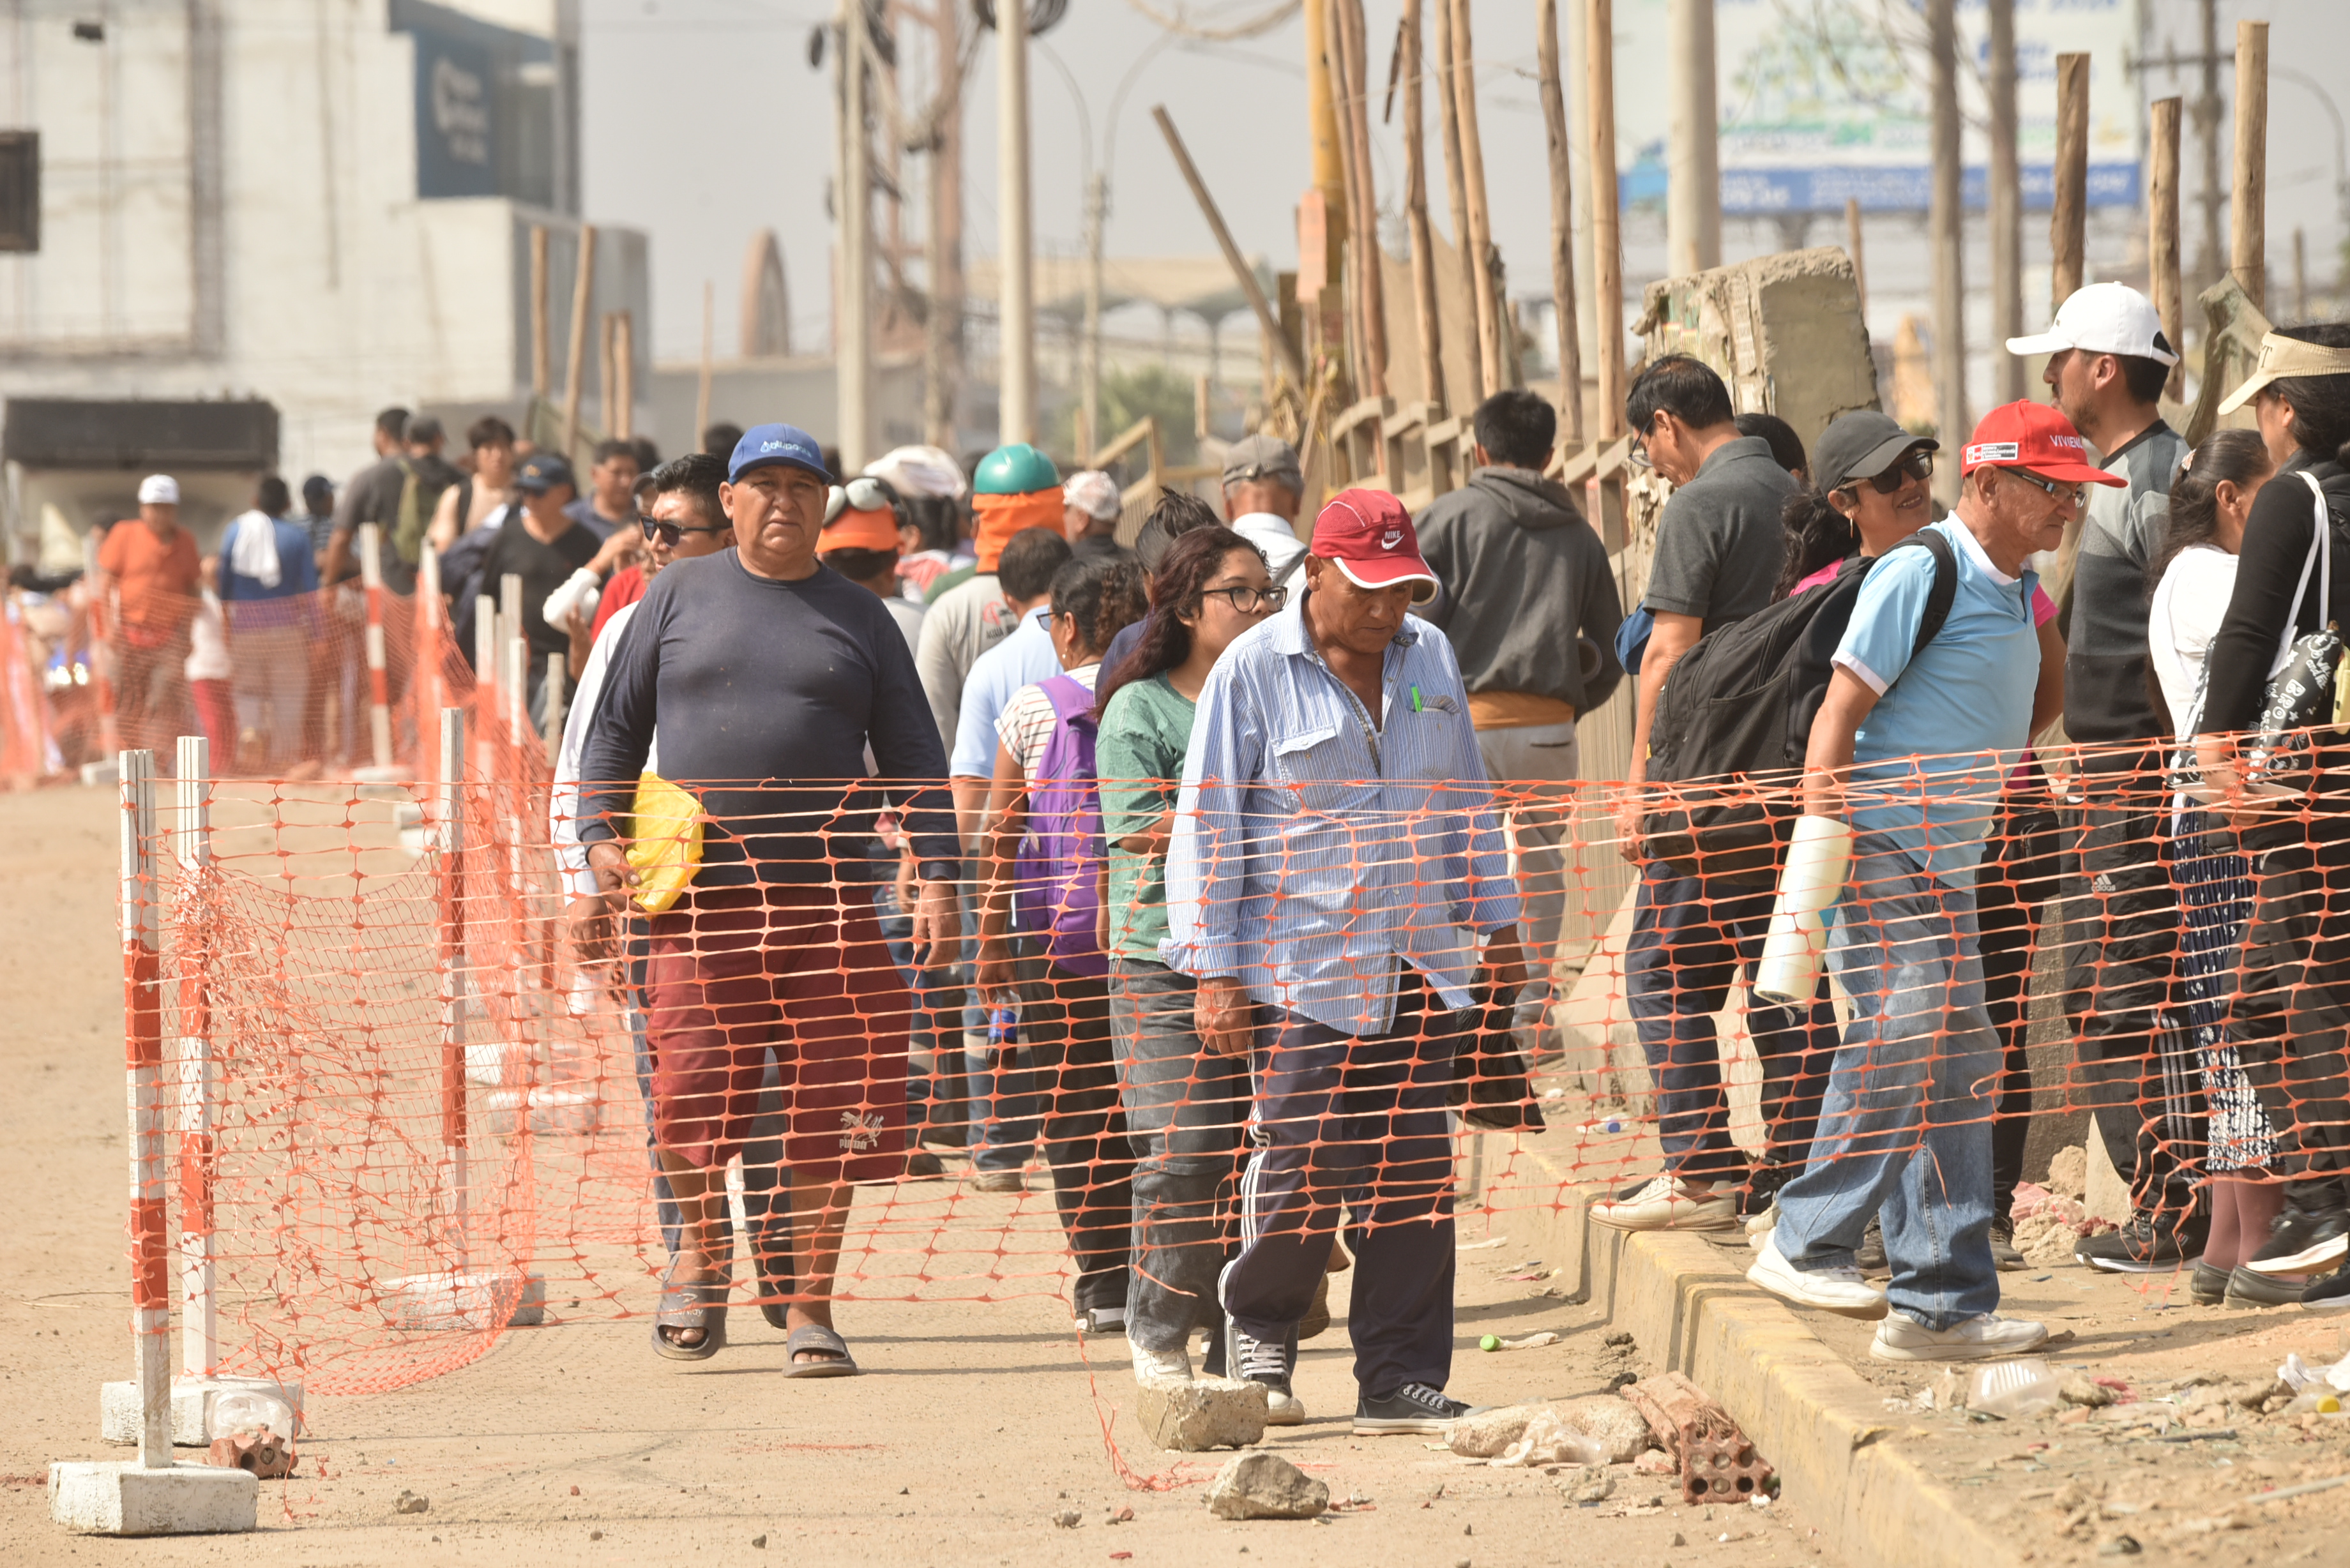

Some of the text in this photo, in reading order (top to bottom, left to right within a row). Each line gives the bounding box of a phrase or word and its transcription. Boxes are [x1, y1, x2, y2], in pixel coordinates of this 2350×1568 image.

[1384, 530, 1400, 539] NIKE
[2091, 884, 2116, 893] adidas
[839, 1138, 867, 1150] PUMA
